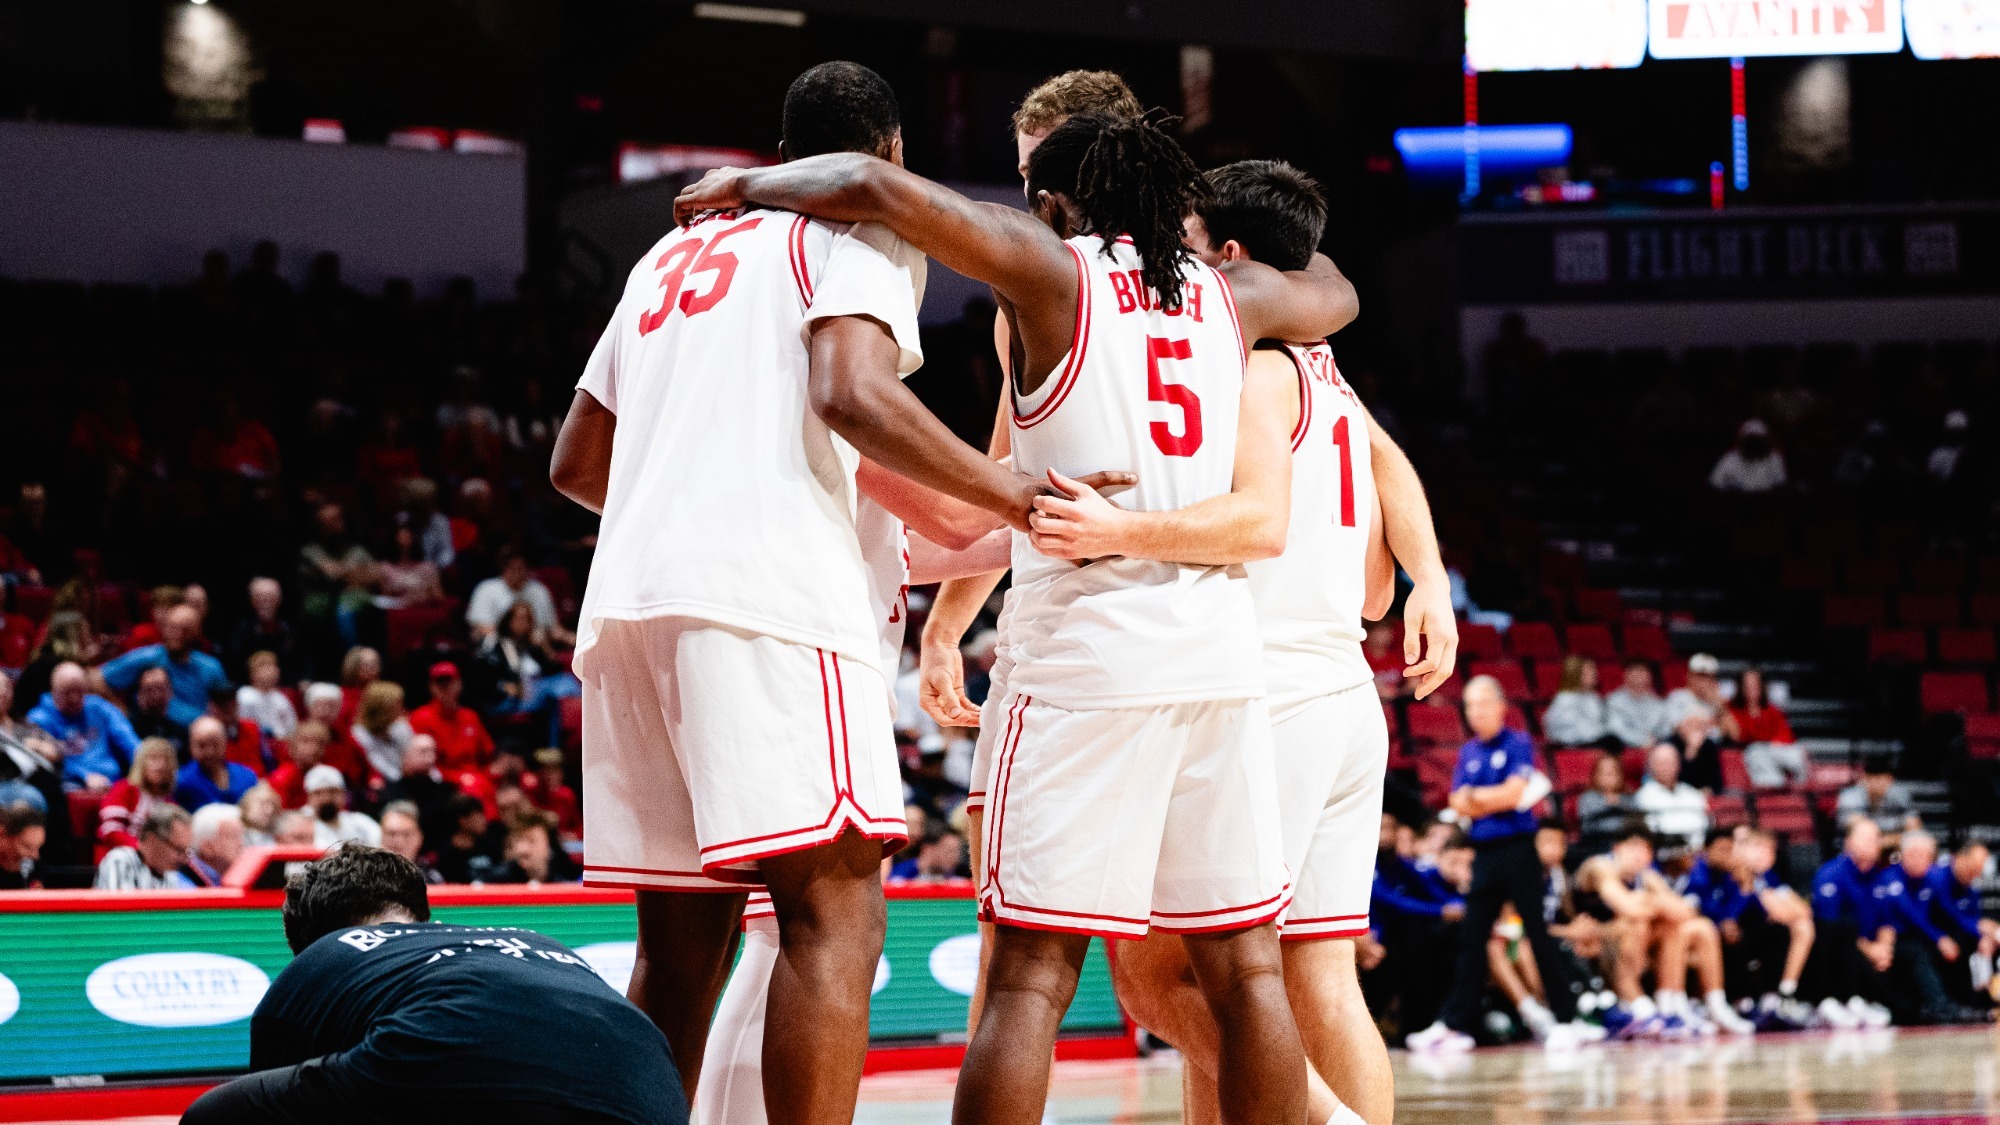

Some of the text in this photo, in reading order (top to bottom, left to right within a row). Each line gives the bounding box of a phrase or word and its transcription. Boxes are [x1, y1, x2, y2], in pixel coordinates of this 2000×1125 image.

[638, 217, 764, 337] 35
[1626, 223, 1886, 280] FLIGHT DECK
[1108, 268, 1204, 323] BUH
[1146, 334, 1203, 457] 5
[112, 968, 241, 998] COUNTRY
